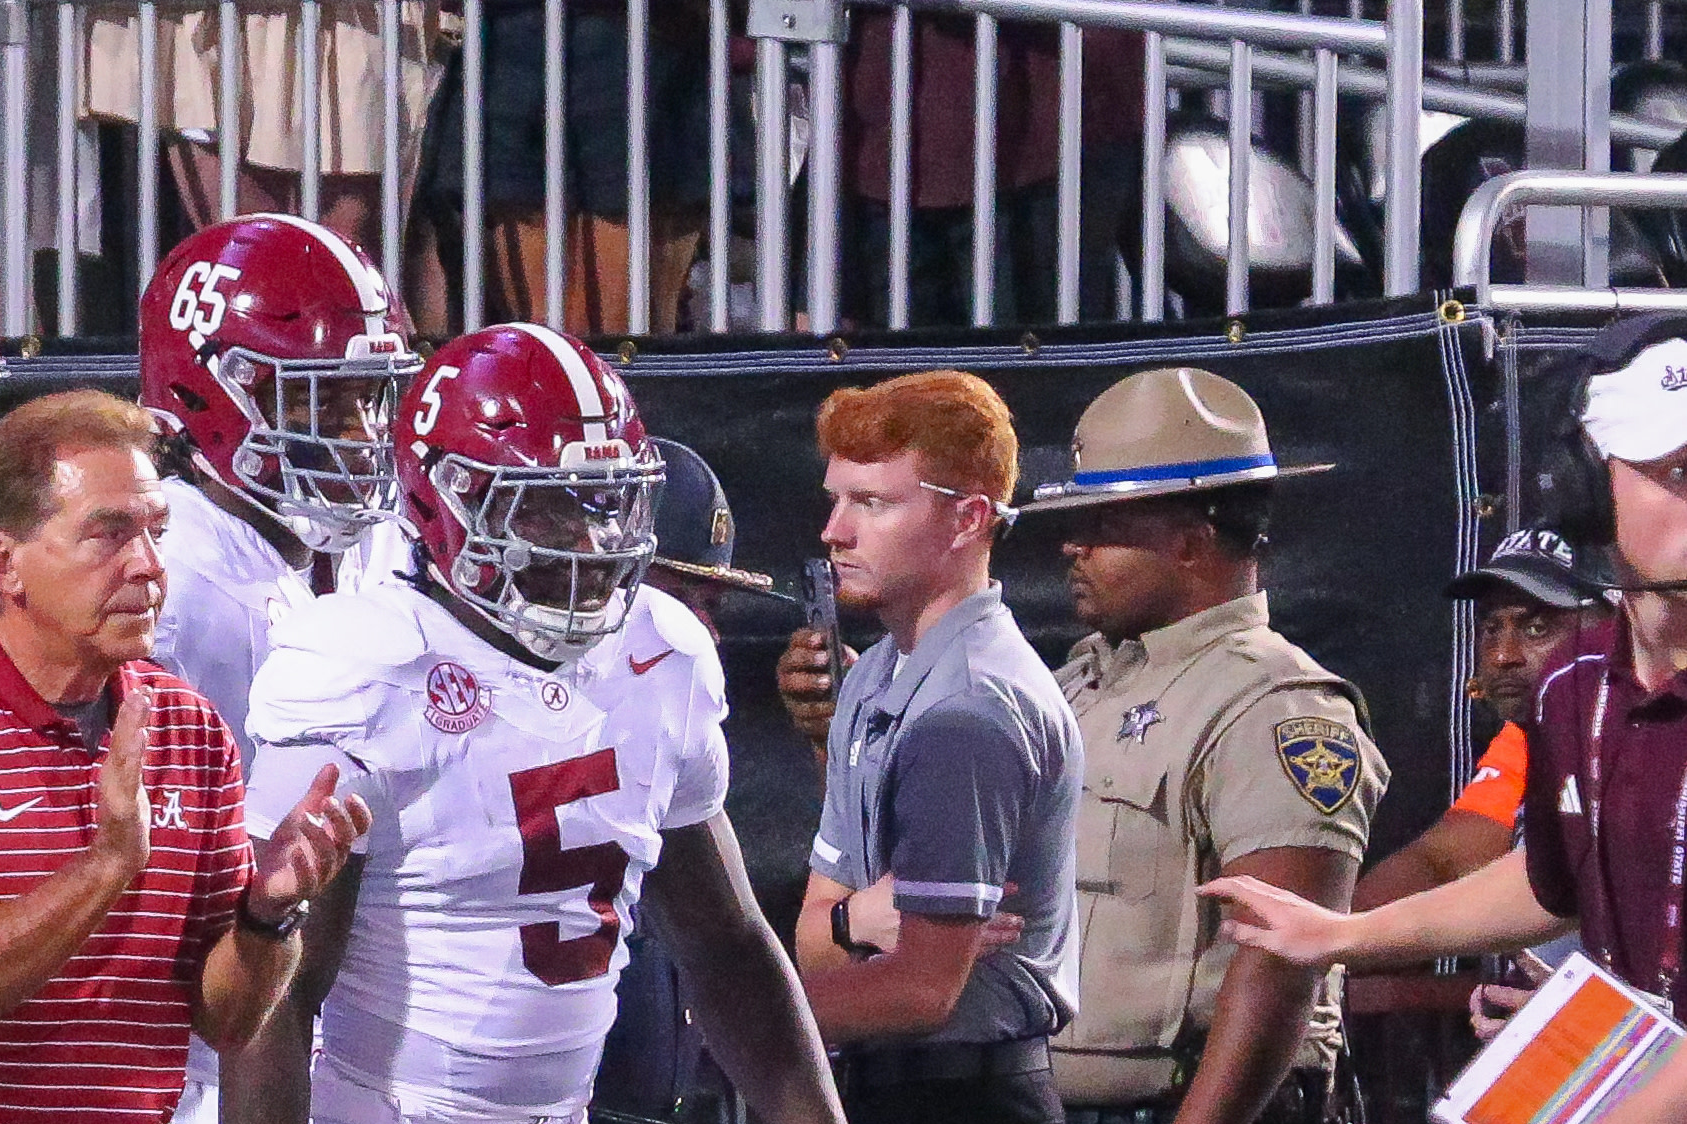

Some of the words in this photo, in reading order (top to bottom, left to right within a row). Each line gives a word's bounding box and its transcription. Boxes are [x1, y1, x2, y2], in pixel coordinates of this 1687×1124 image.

[169, 261, 242, 335] 65
[414, 365, 461, 436] 5
[435, 703, 489, 731] GRADUATE
[508, 747, 630, 986] 5
